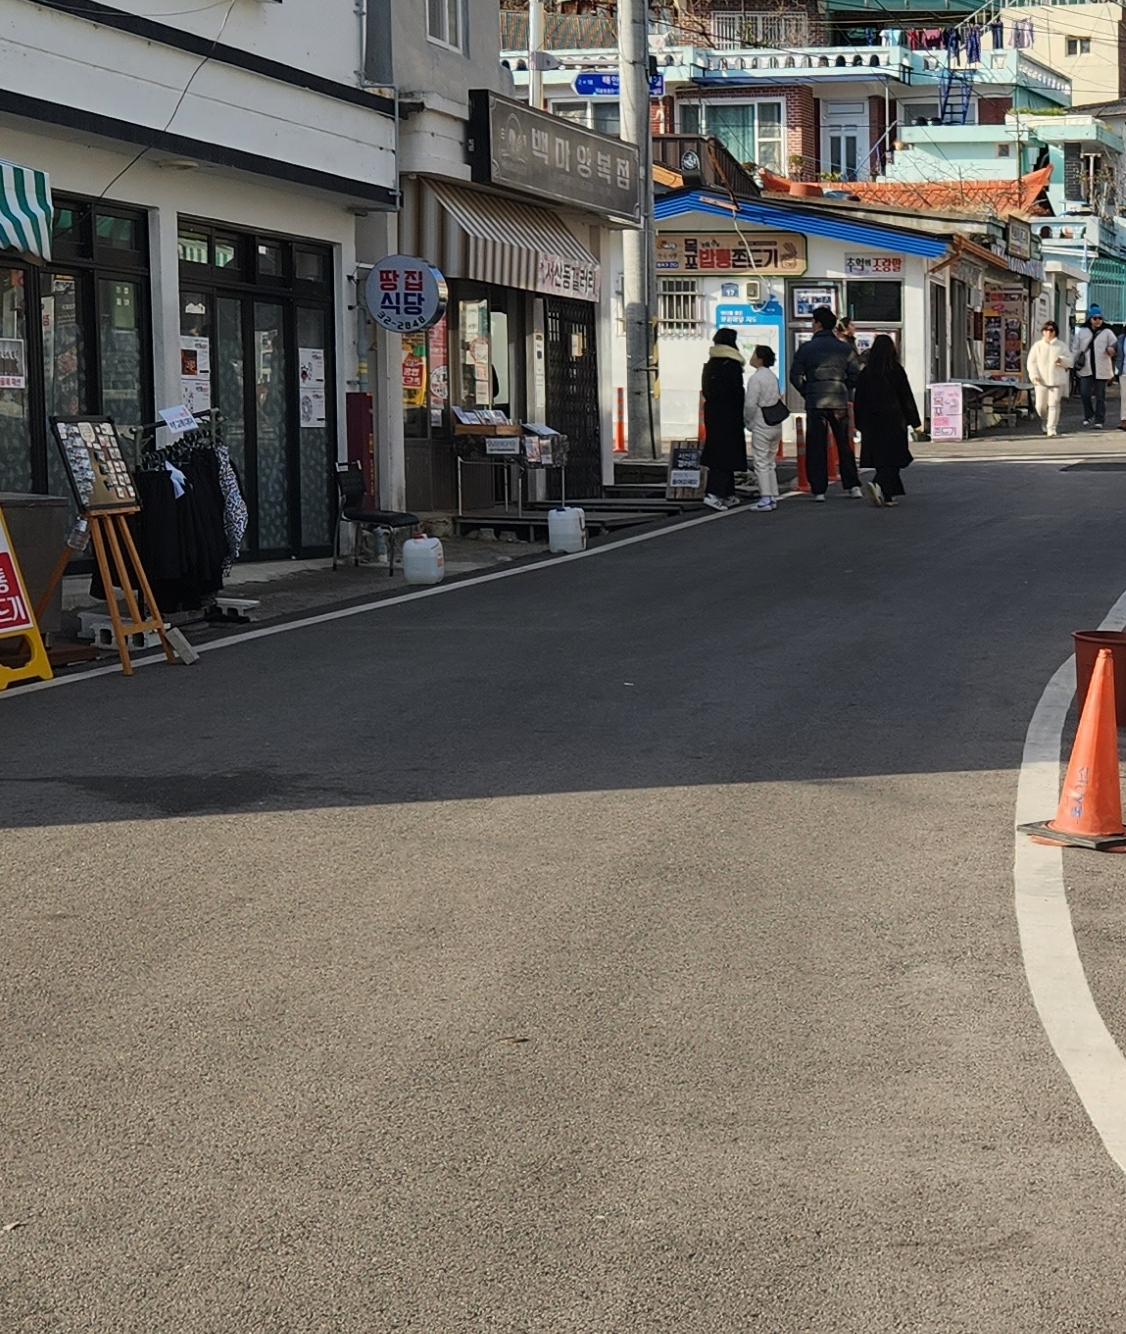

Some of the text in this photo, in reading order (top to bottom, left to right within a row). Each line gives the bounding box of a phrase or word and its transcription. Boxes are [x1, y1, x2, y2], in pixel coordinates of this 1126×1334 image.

[531, 127, 631, 191] 백마양복점
[684, 238, 699, 270] 목포
[379, 269, 424, 292] 땅집
[380, 292, 425, 316] 식당
